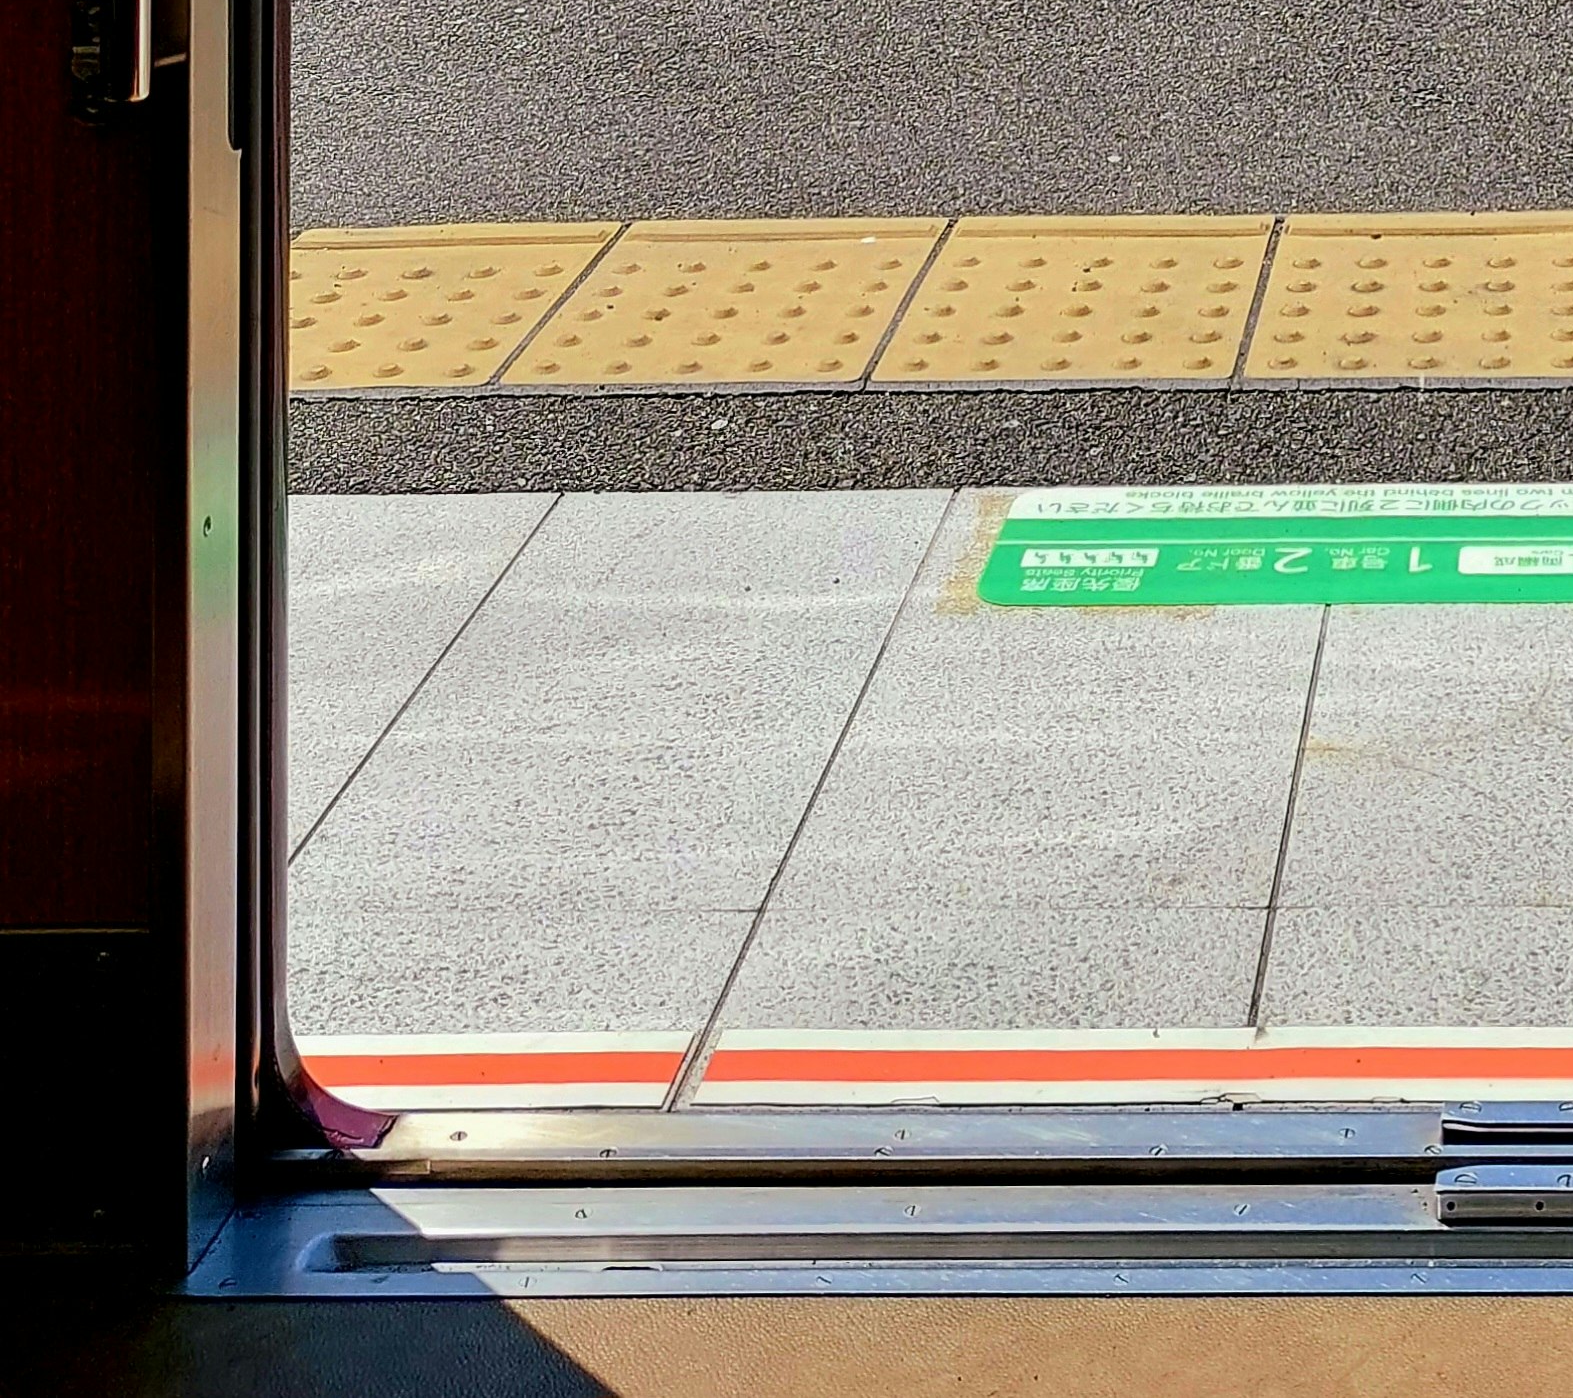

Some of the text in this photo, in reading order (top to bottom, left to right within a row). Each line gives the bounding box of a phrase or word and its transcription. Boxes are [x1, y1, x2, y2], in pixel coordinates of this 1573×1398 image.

[1125, 491, 1194, 500] blocks
[1201, 490, 1264, 500] braille
[1266, 487, 1337, 499] yellow
[1349, 489, 1375, 499] the
[1383, 488, 1454, 498] behind
[1461, 488, 1509, 498] lines
[1516, 487, 1553, 497] two
[1188, 548, 1266, 559] Door No.
[1324, 547, 1390, 557] Car No.
[1273, 547, 1313, 574] 2
[1408, 546, 1433, 573] 1
[1025, 567, 1144, 577] Priority Seats
[1020, 576, 1141, 591] 優先座席
